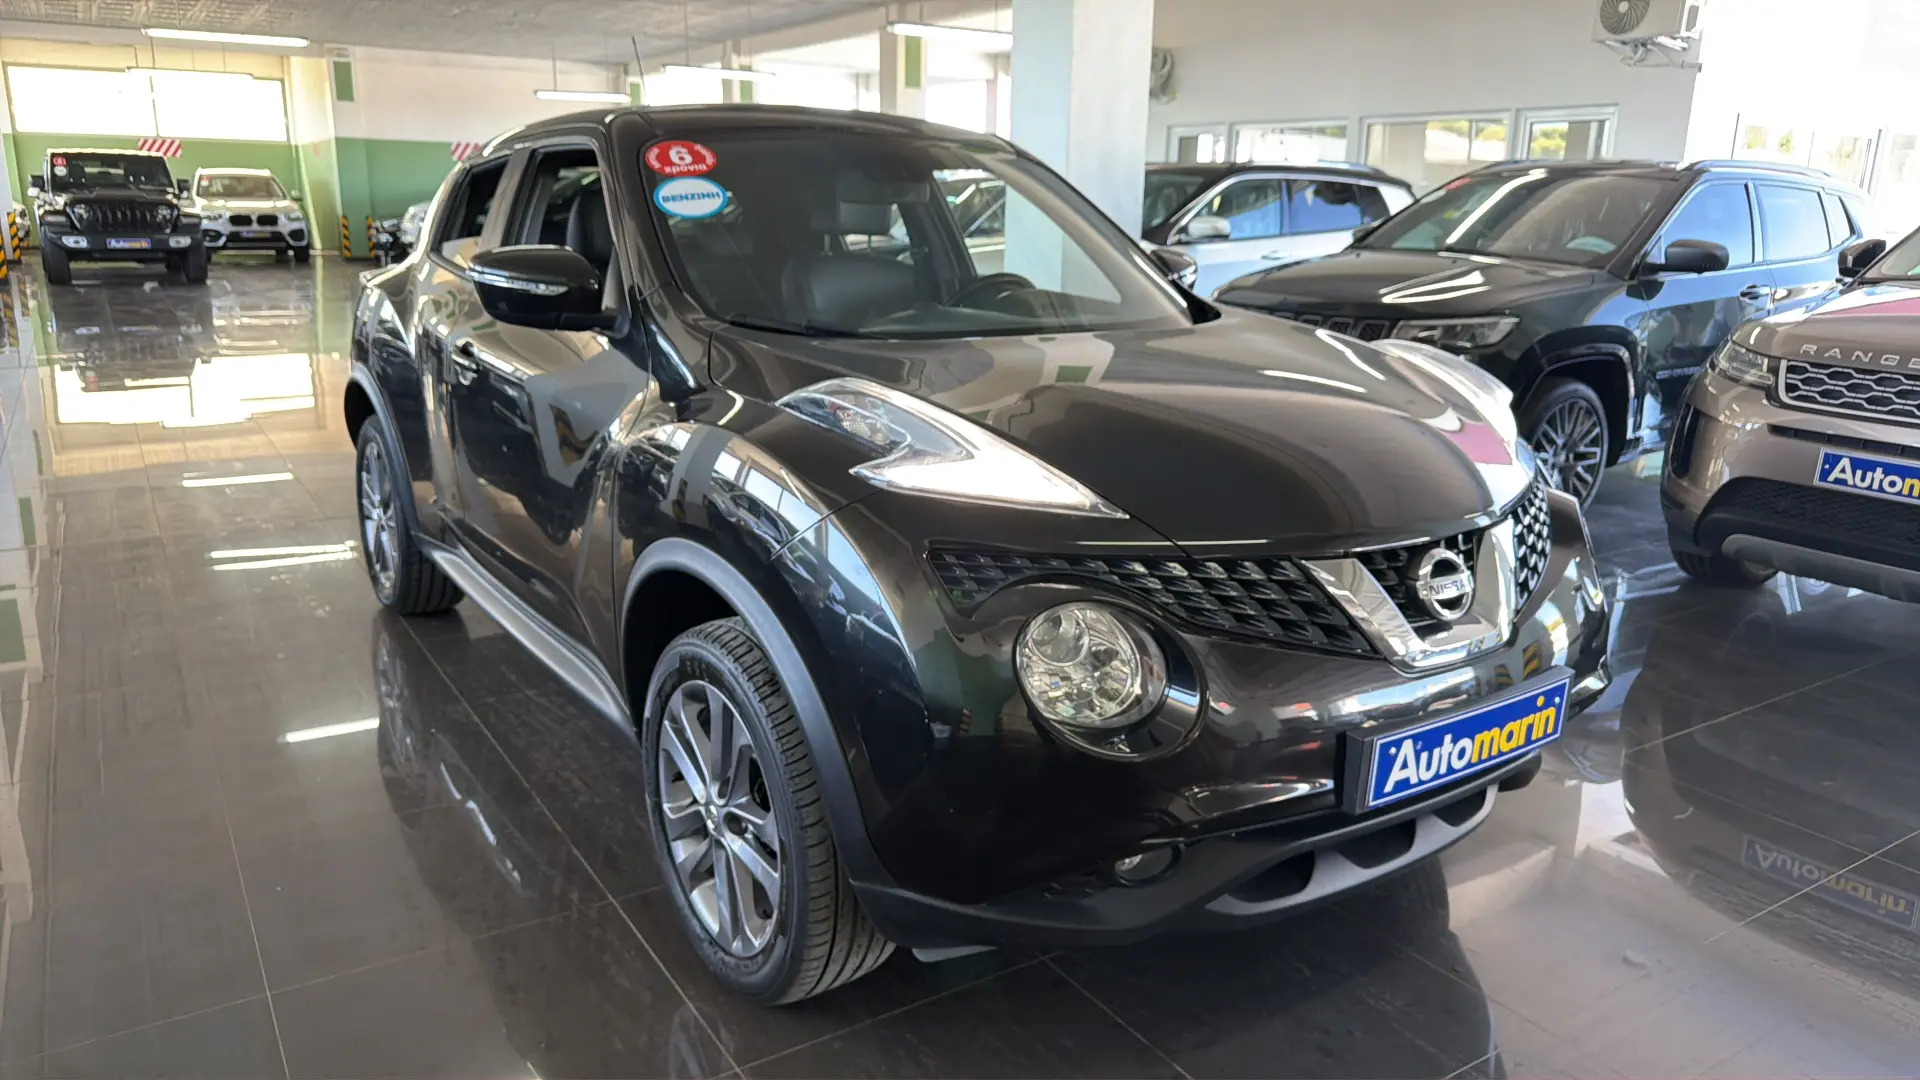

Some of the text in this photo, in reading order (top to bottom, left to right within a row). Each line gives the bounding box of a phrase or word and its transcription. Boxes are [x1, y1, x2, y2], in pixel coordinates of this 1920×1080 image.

[668, 146, 693, 165] 6
[1428, 576, 1470, 596] NISSA
[1383, 695, 1557, 793] Automarin
